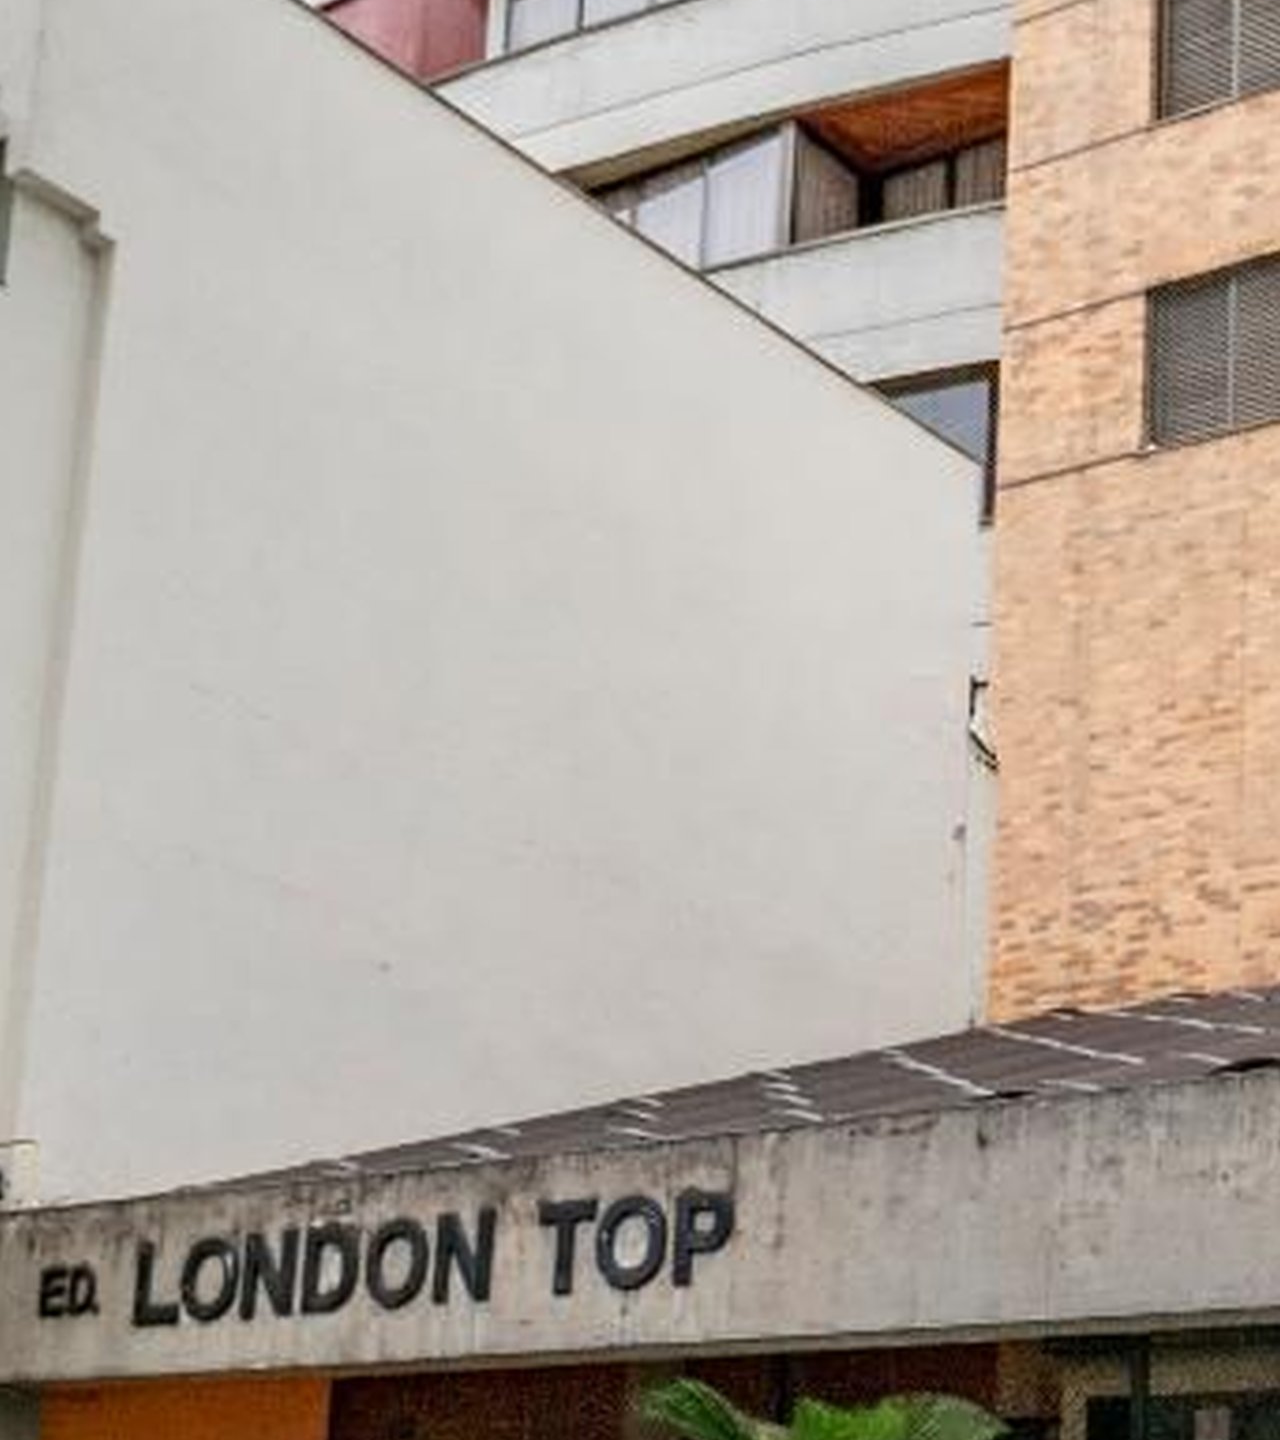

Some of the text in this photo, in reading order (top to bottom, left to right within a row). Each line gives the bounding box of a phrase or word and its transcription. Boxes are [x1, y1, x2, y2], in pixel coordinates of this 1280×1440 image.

[38, 1185, 736, 1328] ED. LONDON TOP
